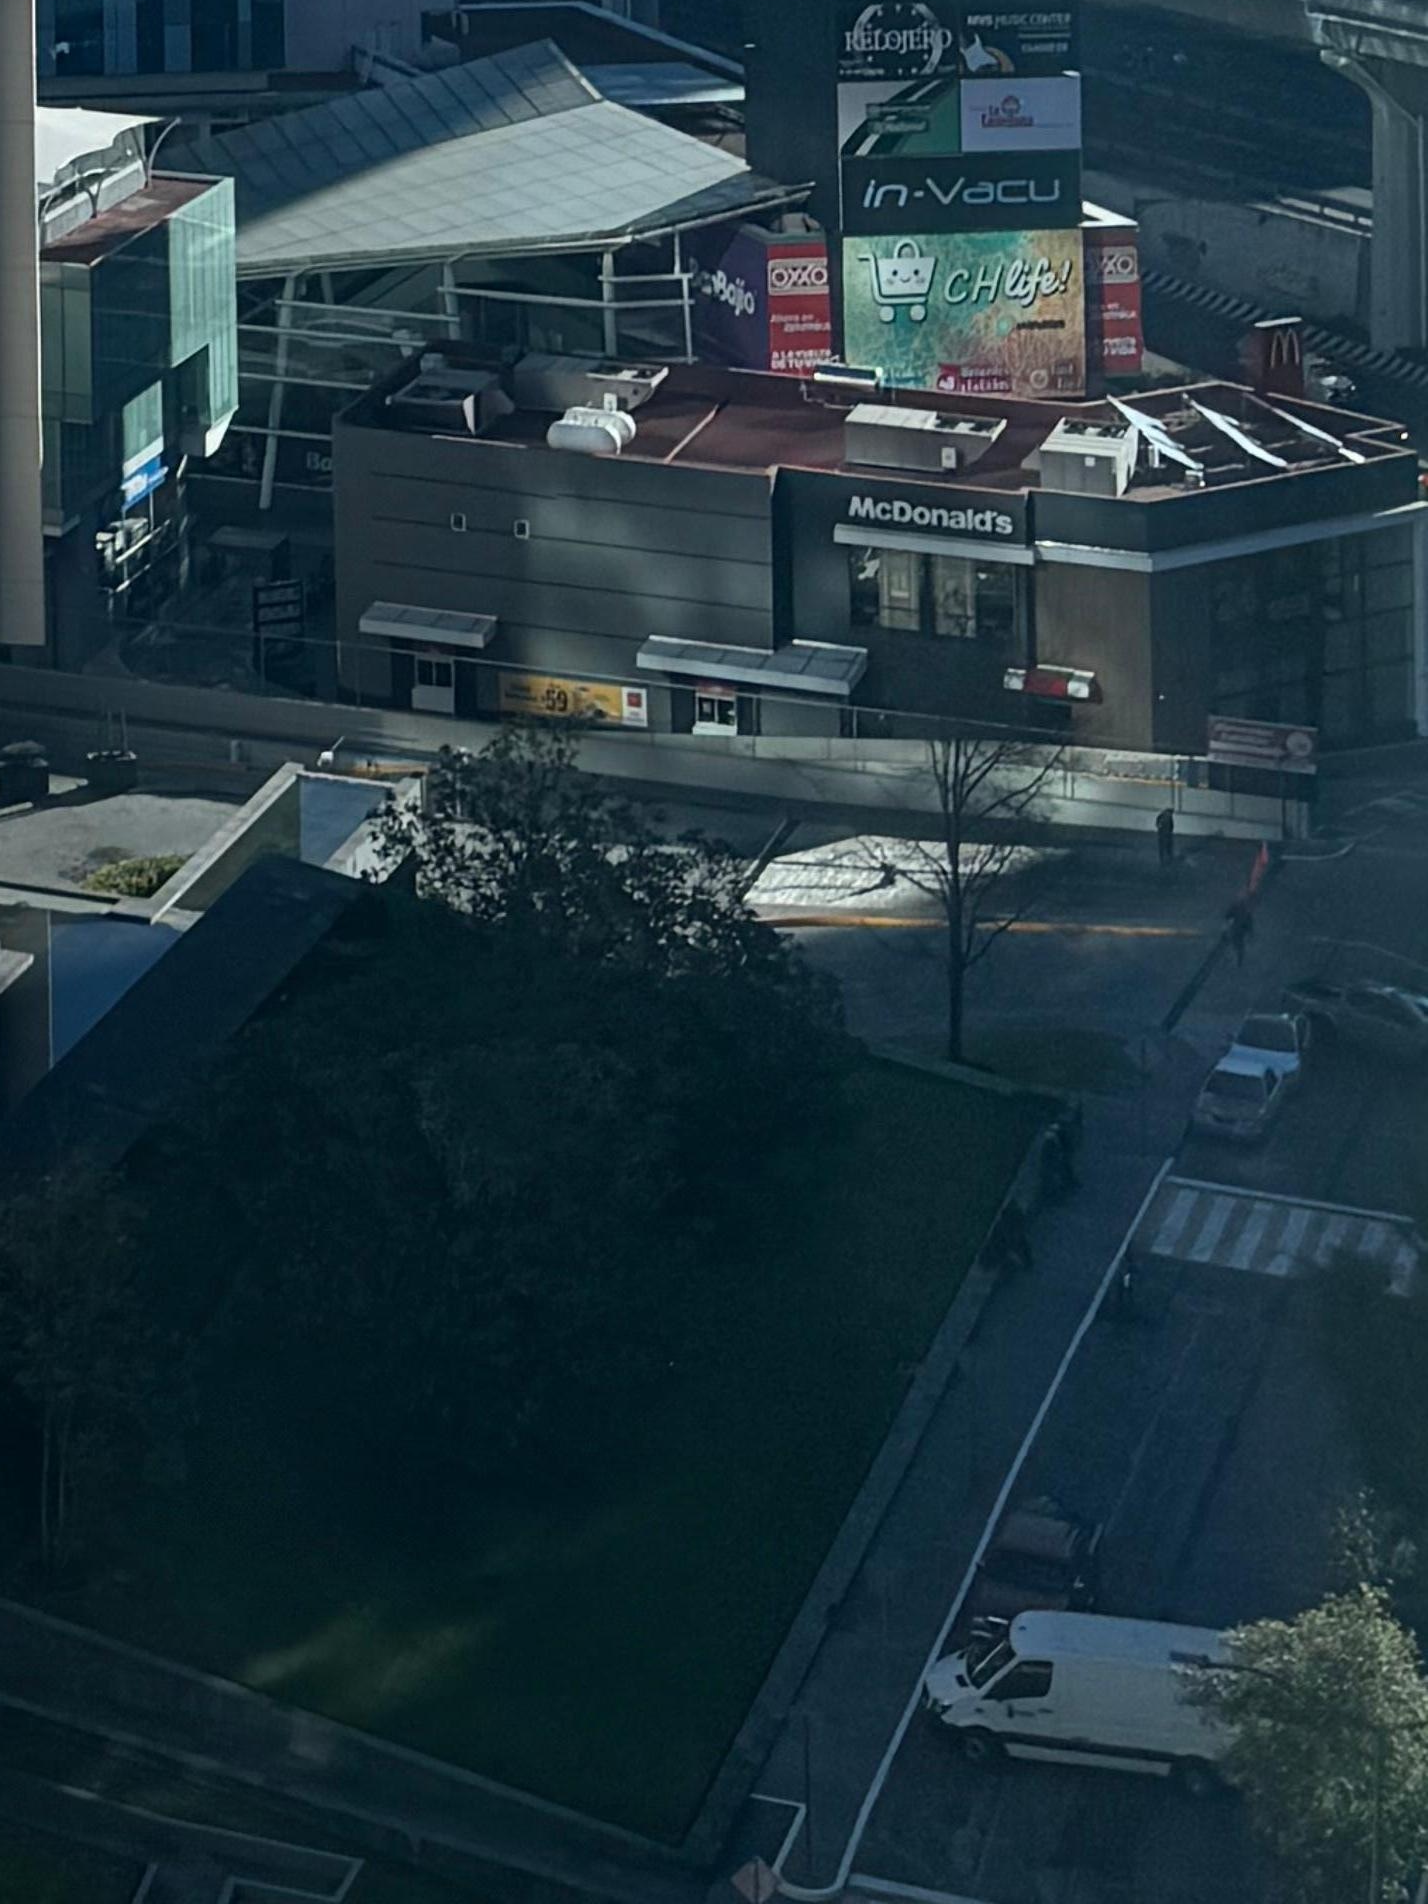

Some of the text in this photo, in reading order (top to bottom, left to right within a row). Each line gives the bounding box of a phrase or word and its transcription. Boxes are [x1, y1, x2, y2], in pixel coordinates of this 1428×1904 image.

[845, 25, 952, 54] RELOJERO
[771, 266, 828, 287] OXXO
[849, 495, 1014, 535] McDonald's
